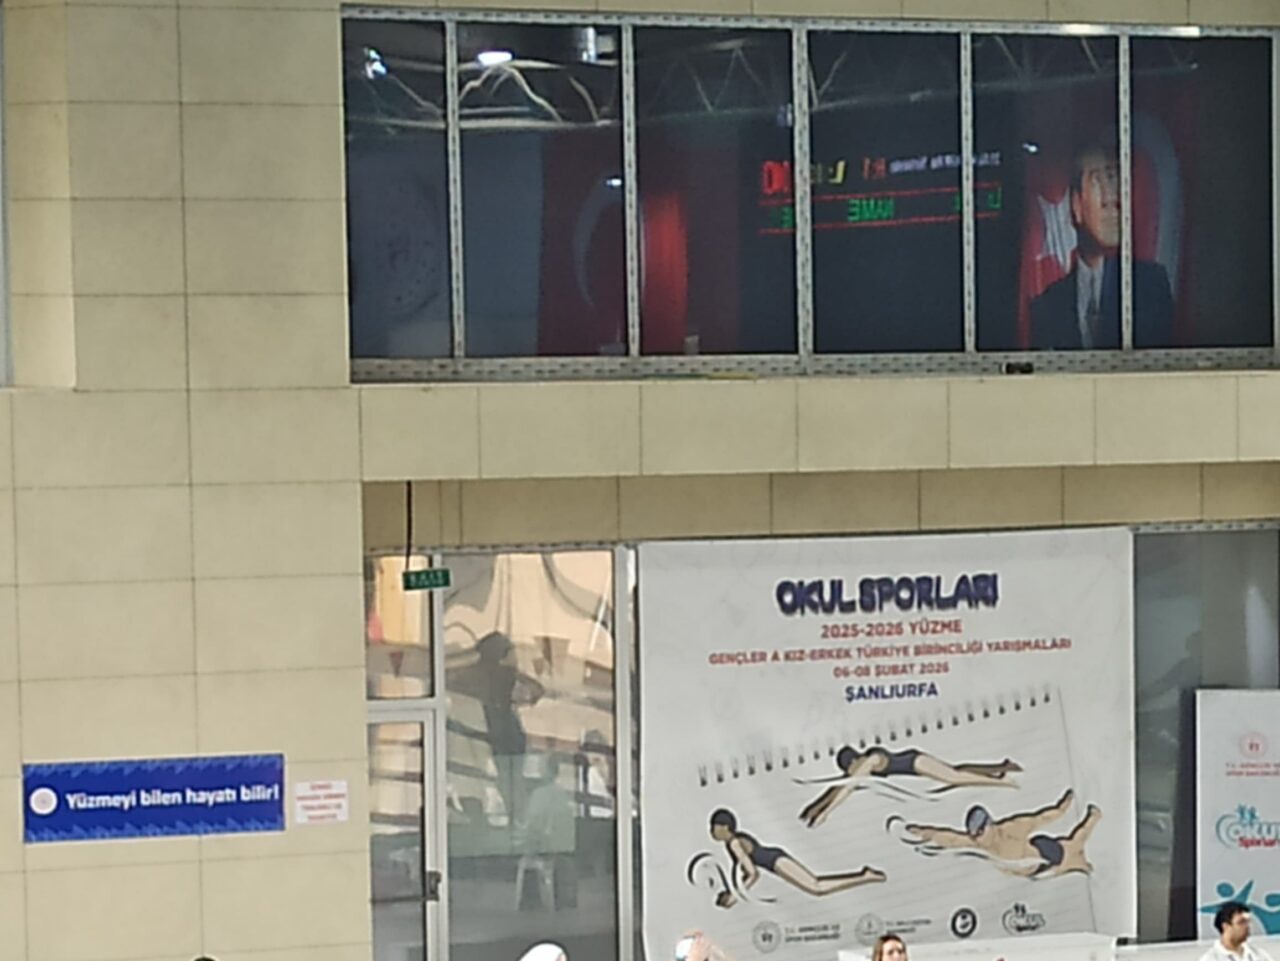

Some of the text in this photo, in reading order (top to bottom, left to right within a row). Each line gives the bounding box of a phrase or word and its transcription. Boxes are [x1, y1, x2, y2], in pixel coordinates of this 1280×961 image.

[777, 573, 999, 616] OKUL SPORLARI
[821, 618, 963, 638] 2025-2026 YÜZME
[709, 651, 768, 665] GENÇLER
[845, 682, 938, 703] ŞANLIURFA
[65, 789, 137, 811] Yüzmeyi
[140, 788, 182, 806] bilen
[185, 786, 236, 807] hayatı
[240, 783, 279, 801] bilir!
